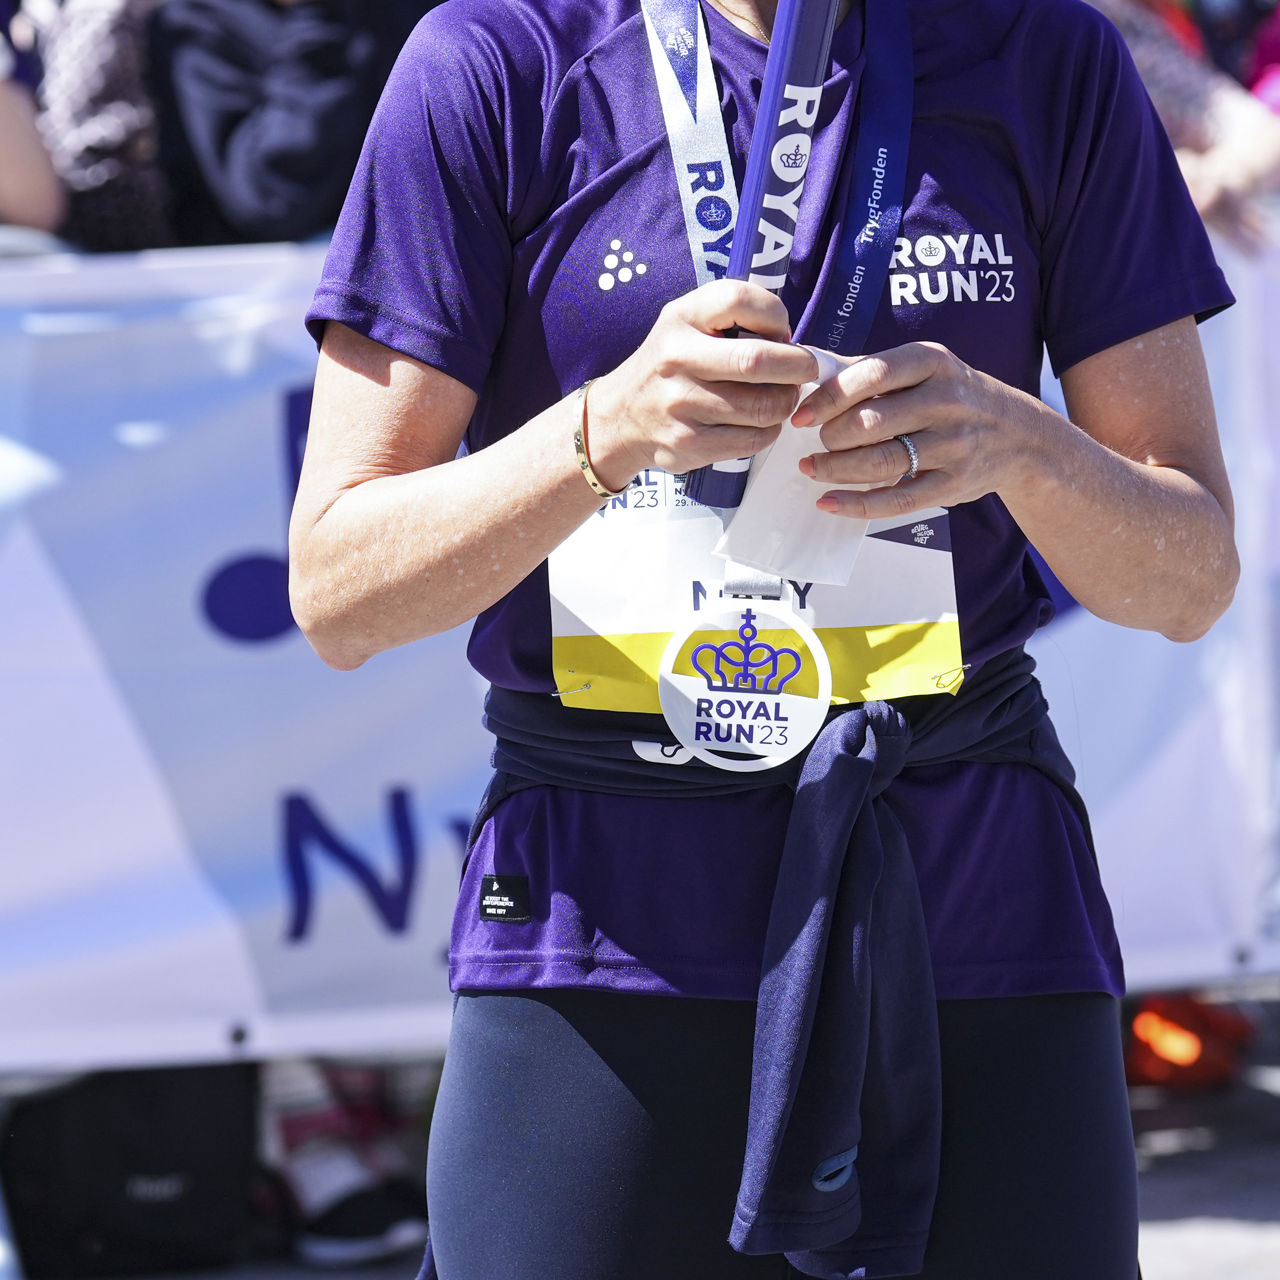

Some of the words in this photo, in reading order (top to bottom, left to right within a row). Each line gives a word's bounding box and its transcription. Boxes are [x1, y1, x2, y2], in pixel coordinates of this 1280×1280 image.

[860, 147, 888, 244] TrygFonden
[888, 233, 1013, 269] ROYAL
[837, 265, 866, 318] fonden
[696, 698, 789, 722] ROYAL
